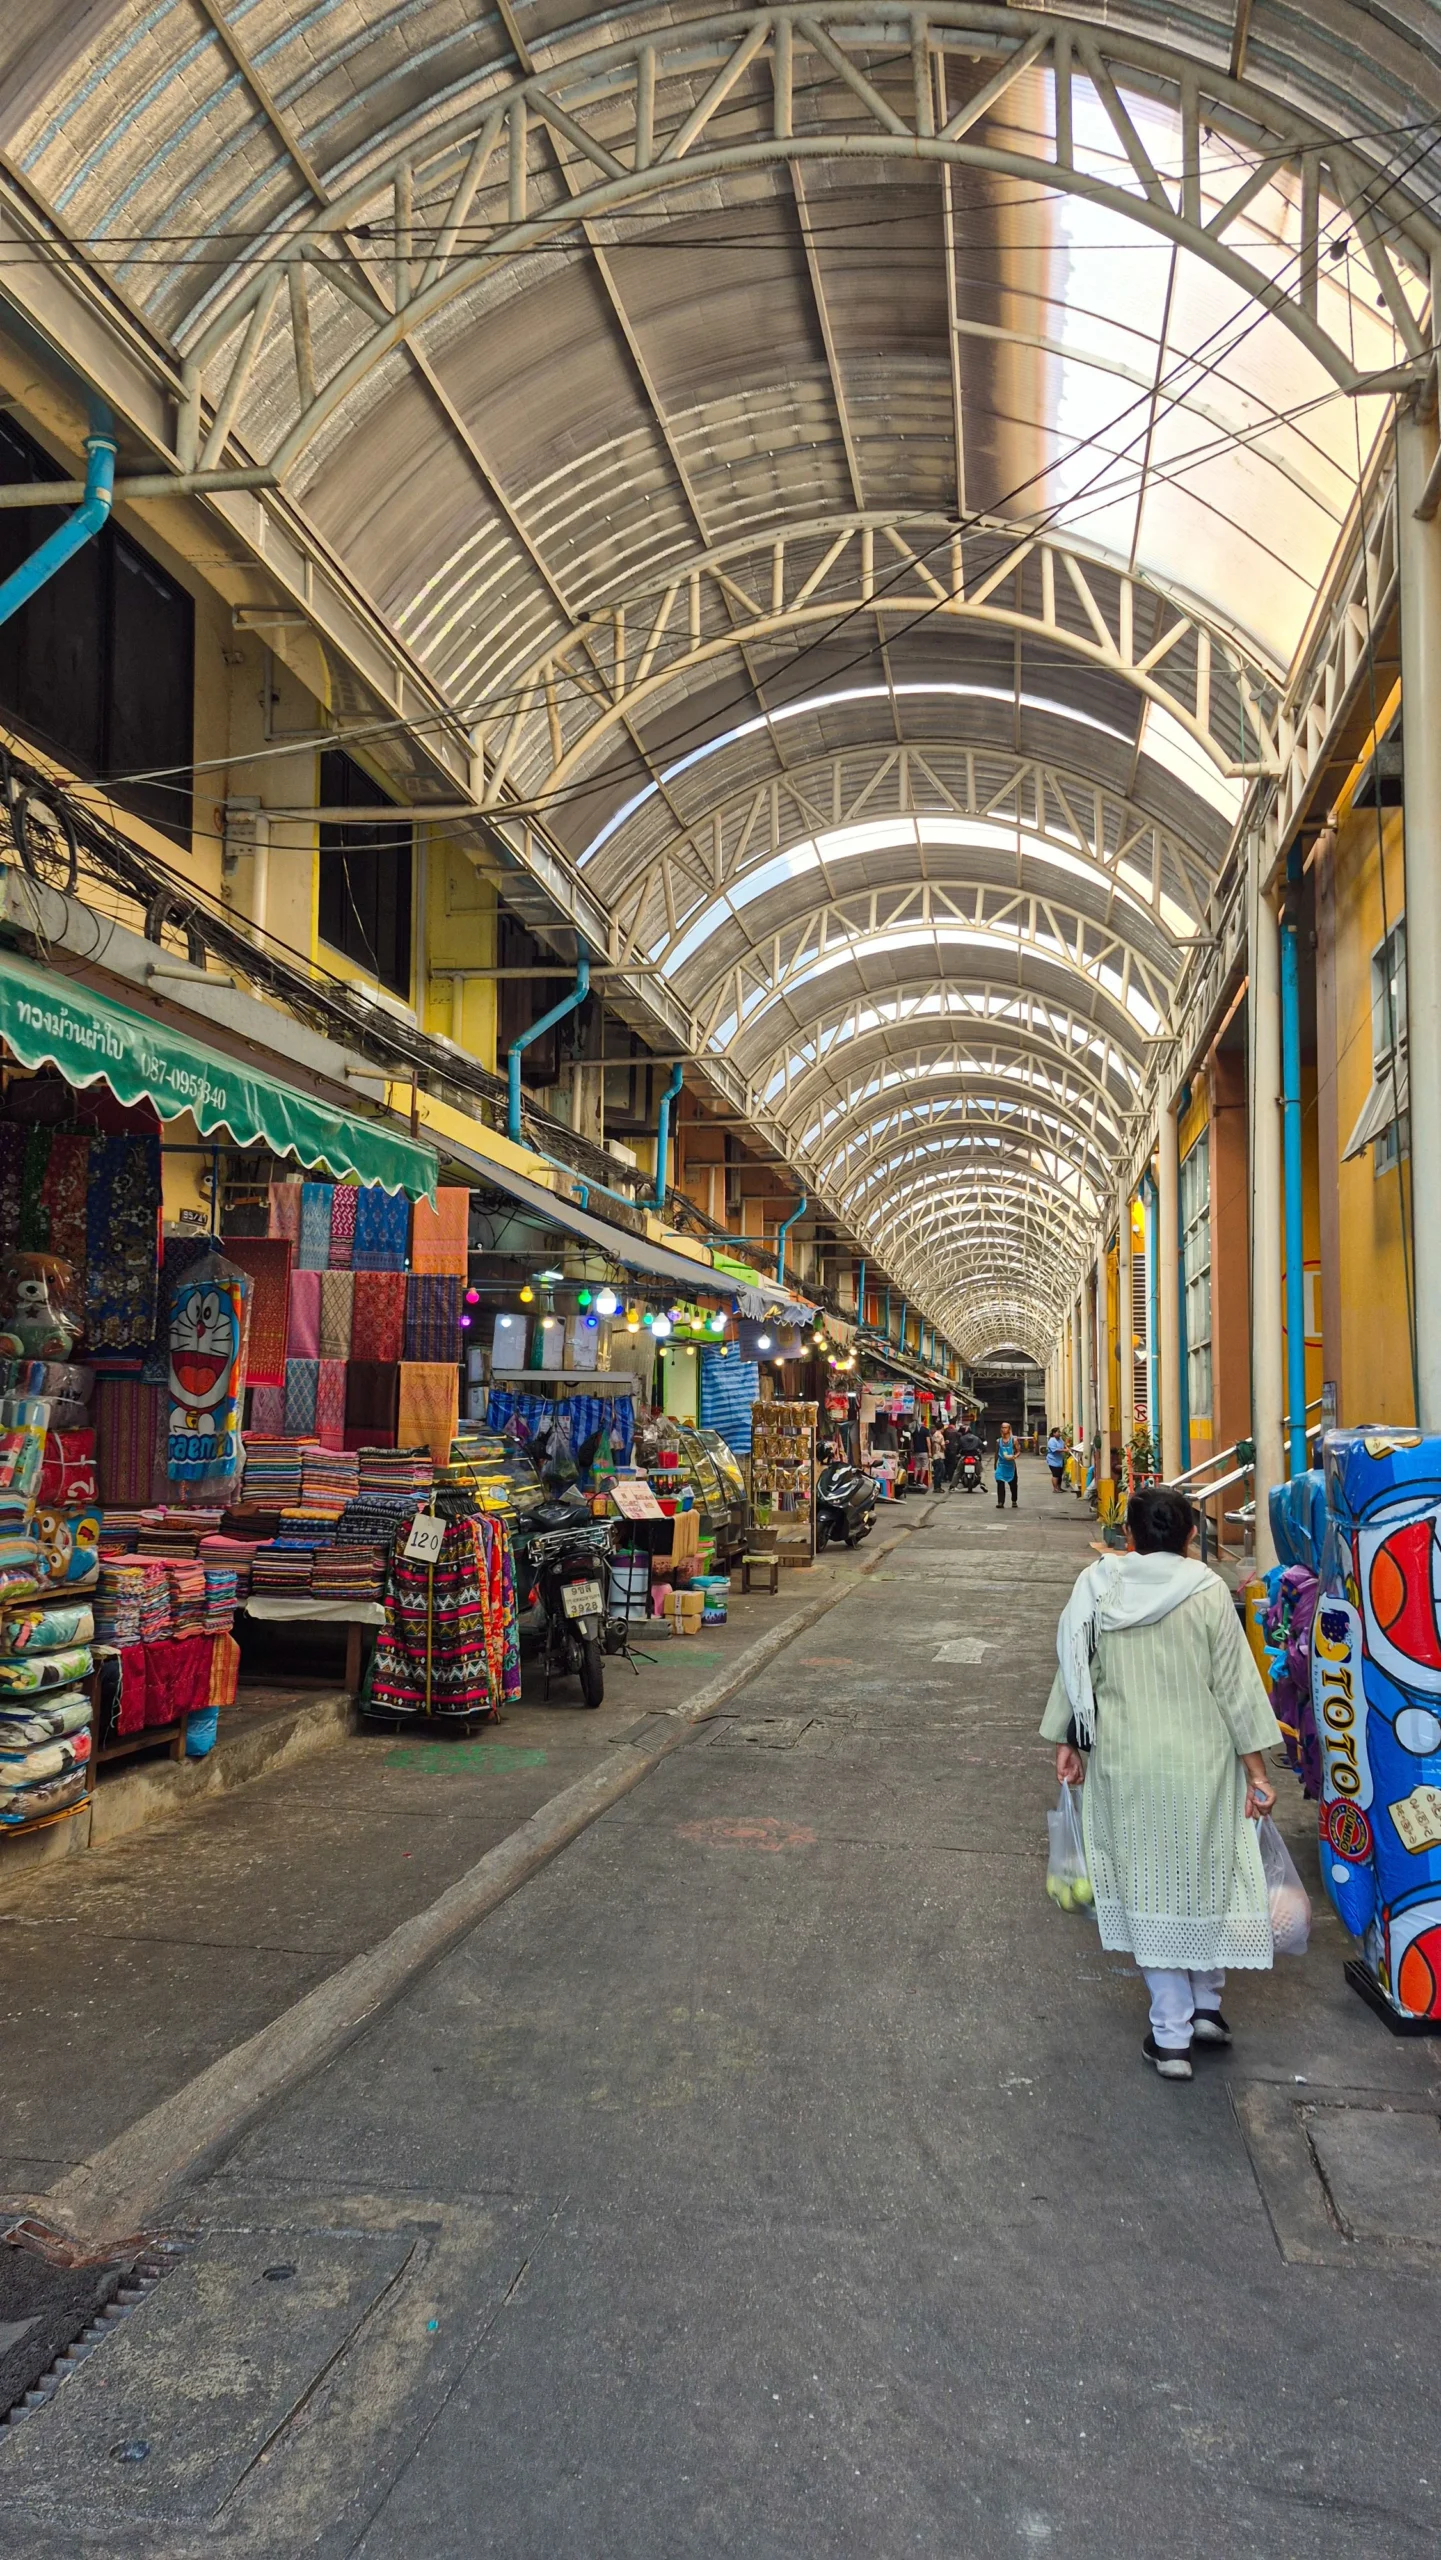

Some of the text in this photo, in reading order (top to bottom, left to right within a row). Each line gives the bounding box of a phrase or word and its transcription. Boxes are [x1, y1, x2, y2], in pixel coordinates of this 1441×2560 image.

[410, 1531, 439, 1551] 120
[571, 1601, 598, 1614] 3928
[1322, 1666, 1361, 1798] TOTO
[1339, 1805, 1357, 1854] JUMBO
